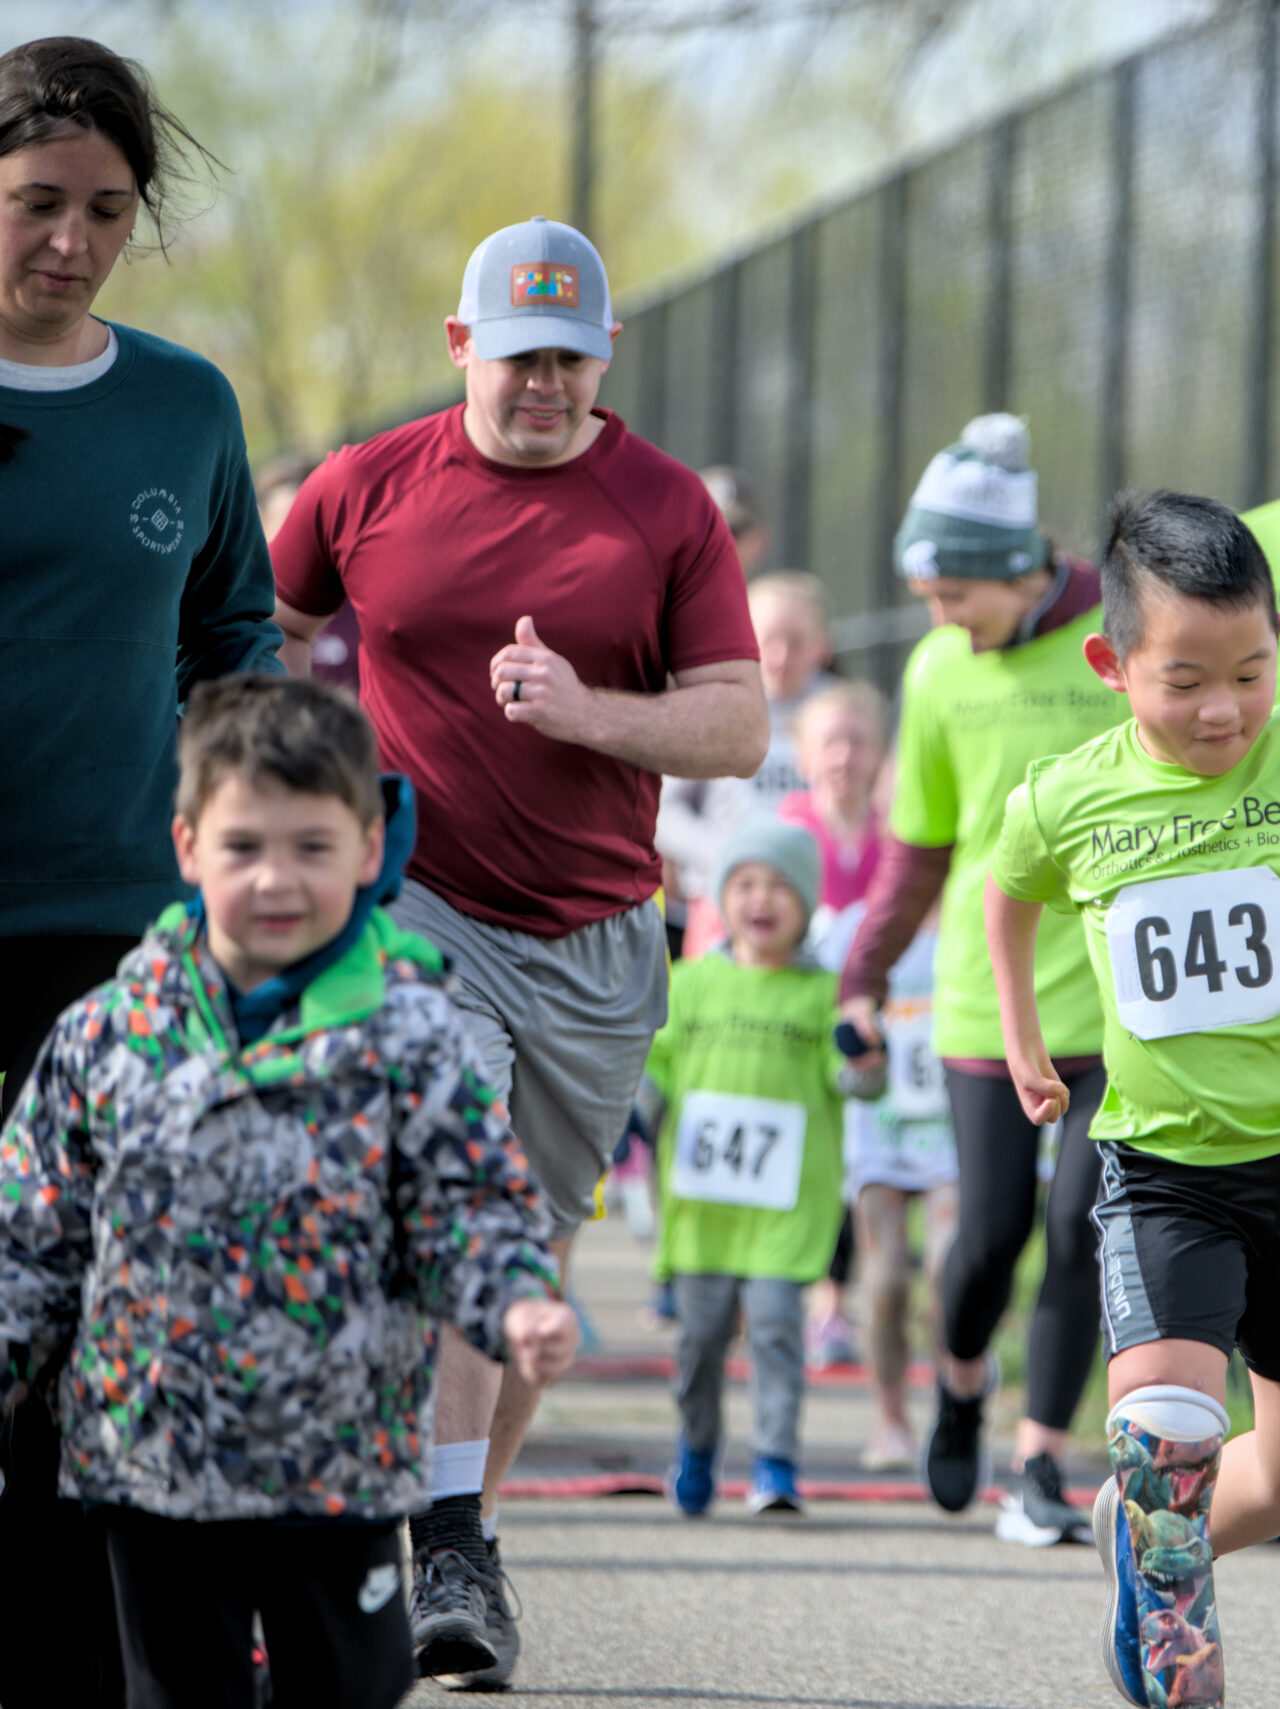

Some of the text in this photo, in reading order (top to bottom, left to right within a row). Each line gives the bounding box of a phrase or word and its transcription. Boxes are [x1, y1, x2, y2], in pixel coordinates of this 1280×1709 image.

[132, 488, 181, 514] COLUMBIA
[133, 526, 182, 554] SPORTSWEAR
[1091, 823, 1166, 859] Mary
[1173, 807, 1237, 845] Free
[1134, 902, 1273, 1002] 643
[691, 1118, 780, 1180] 647
